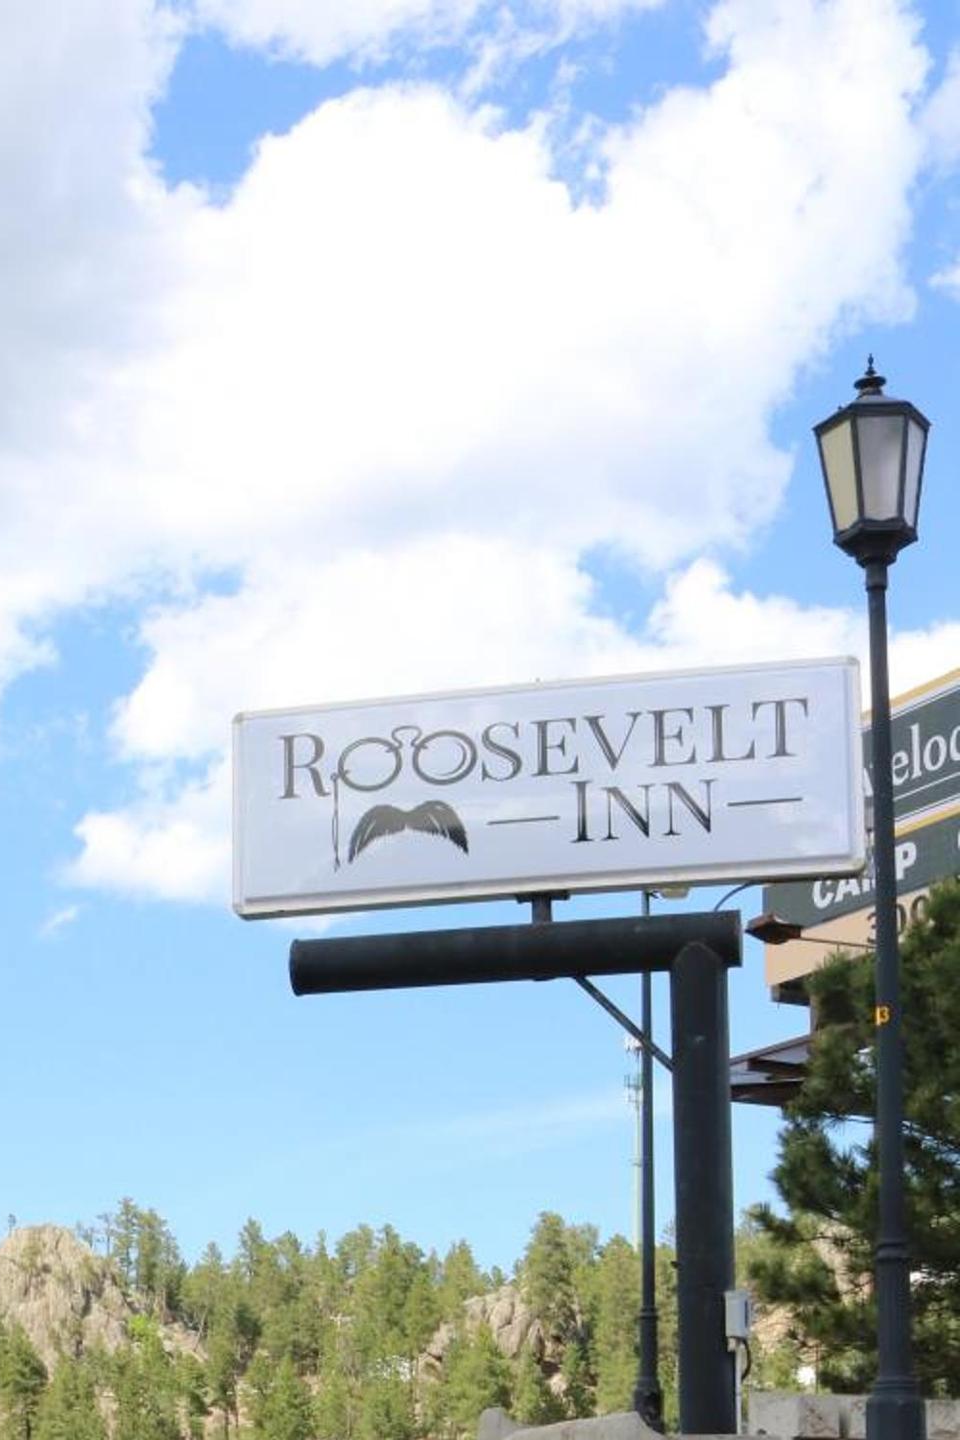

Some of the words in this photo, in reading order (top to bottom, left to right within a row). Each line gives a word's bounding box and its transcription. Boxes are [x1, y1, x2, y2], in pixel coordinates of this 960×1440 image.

[279, 698, 809, 800] ROOSEVELT
[570, 778, 719, 843] INN
[812, 841, 918, 910] CAP
